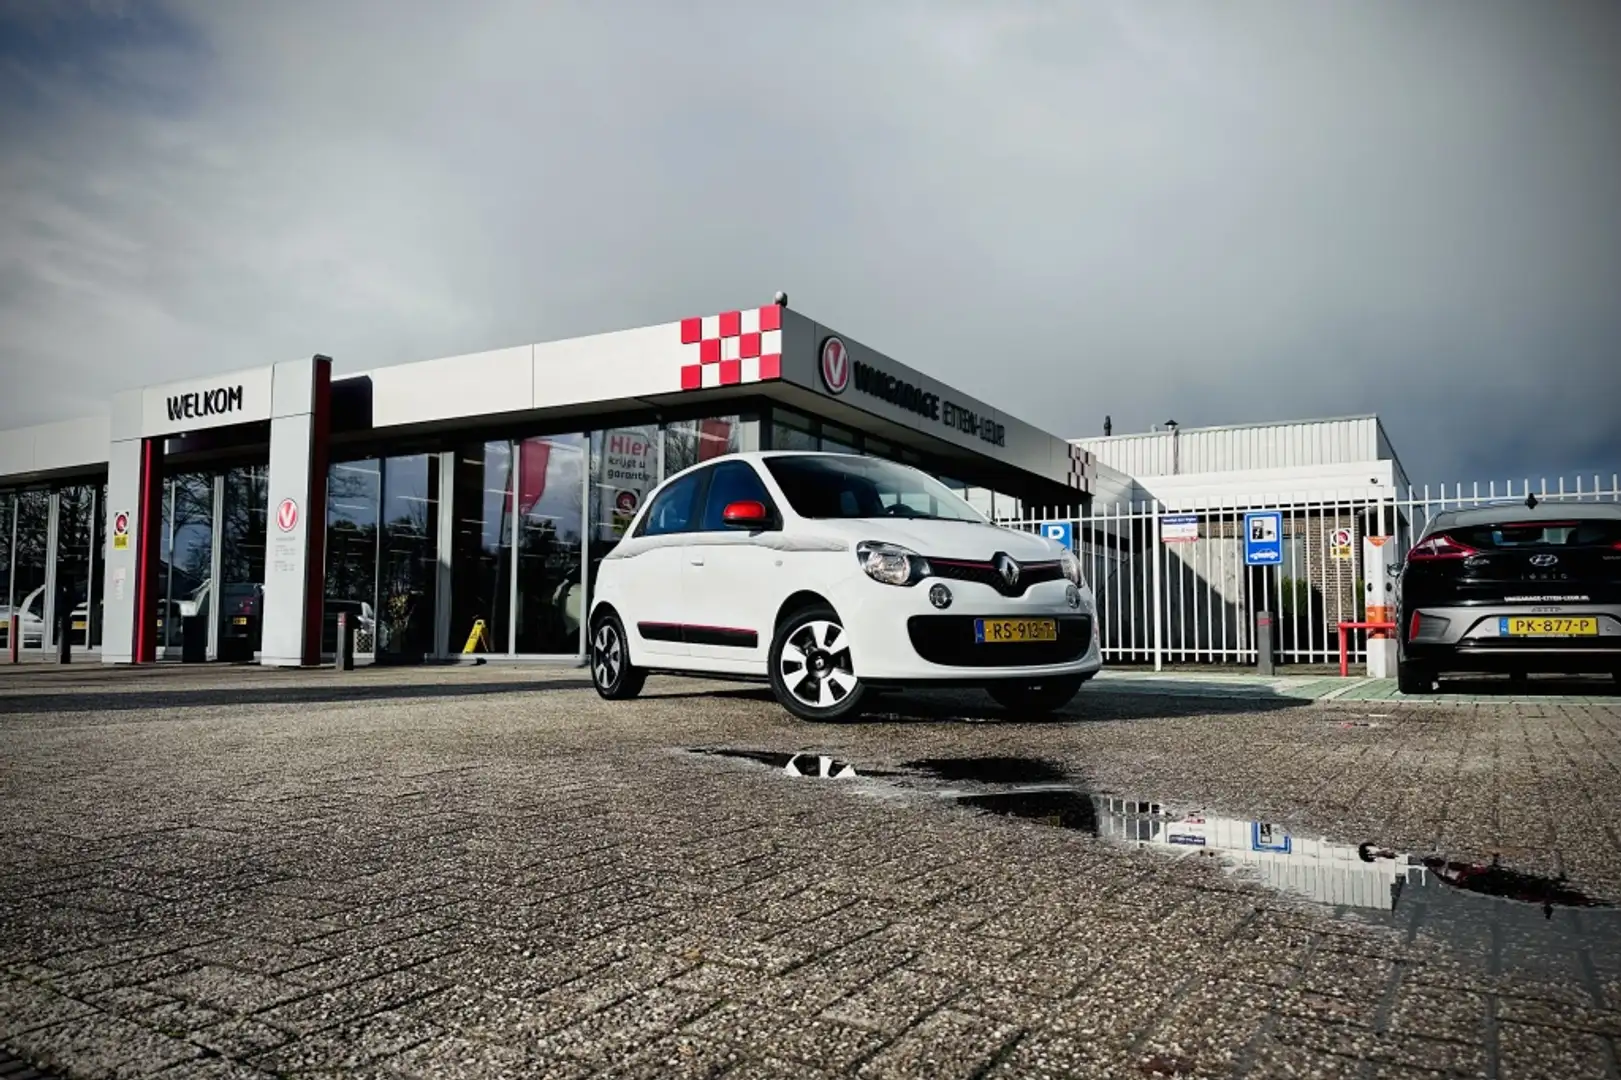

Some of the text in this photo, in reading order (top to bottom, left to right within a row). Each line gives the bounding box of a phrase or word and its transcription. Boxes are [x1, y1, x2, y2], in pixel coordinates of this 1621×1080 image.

[167, 385, 243, 421] WELKOM
[611, 435, 648, 457] Hier
[1516, 620, 1589, 632] PK-877-P
